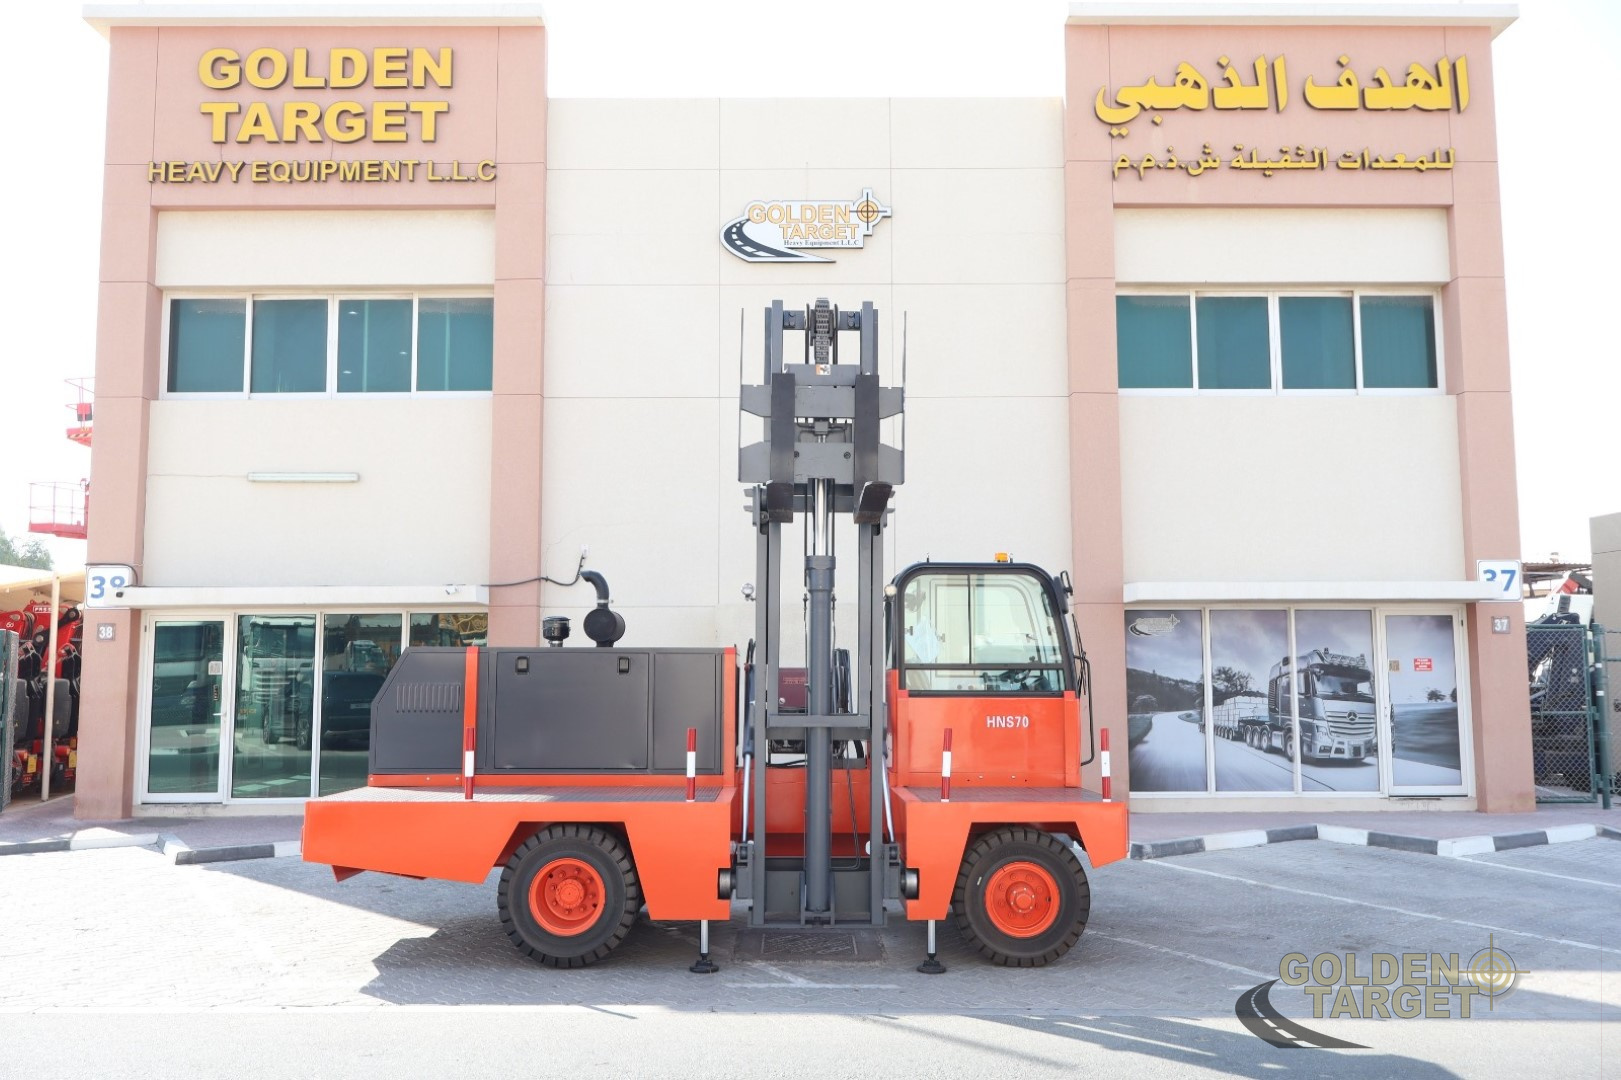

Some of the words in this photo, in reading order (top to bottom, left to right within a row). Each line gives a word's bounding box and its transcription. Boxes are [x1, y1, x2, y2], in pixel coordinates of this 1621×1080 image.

[198, 47, 454, 90] GOLDEN
[1094, 53, 1289, 139] الذهبي
[1303, 53, 1471, 114] الهدف
[200, 100, 450, 144] TARGET
[147, 160, 246, 184] HEAVY
[250, 159, 421, 184] EQUIPMENT
[426, 159, 497, 183] L.L.C
[1229, 143, 1329, 178] الثقيلة
[1335, 146, 1457, 173] للمعدات
[749, 204, 851, 224] GOLDEN
[779, 224, 859, 240] TARGET
[783, 239, 803, 247] Heavy
[804, 239, 840, 247] Equipment
[98, 625, 113, 639] 38
[1494, 618, 1508, 631] 37
[986, 716, 1029, 728] HNS70
